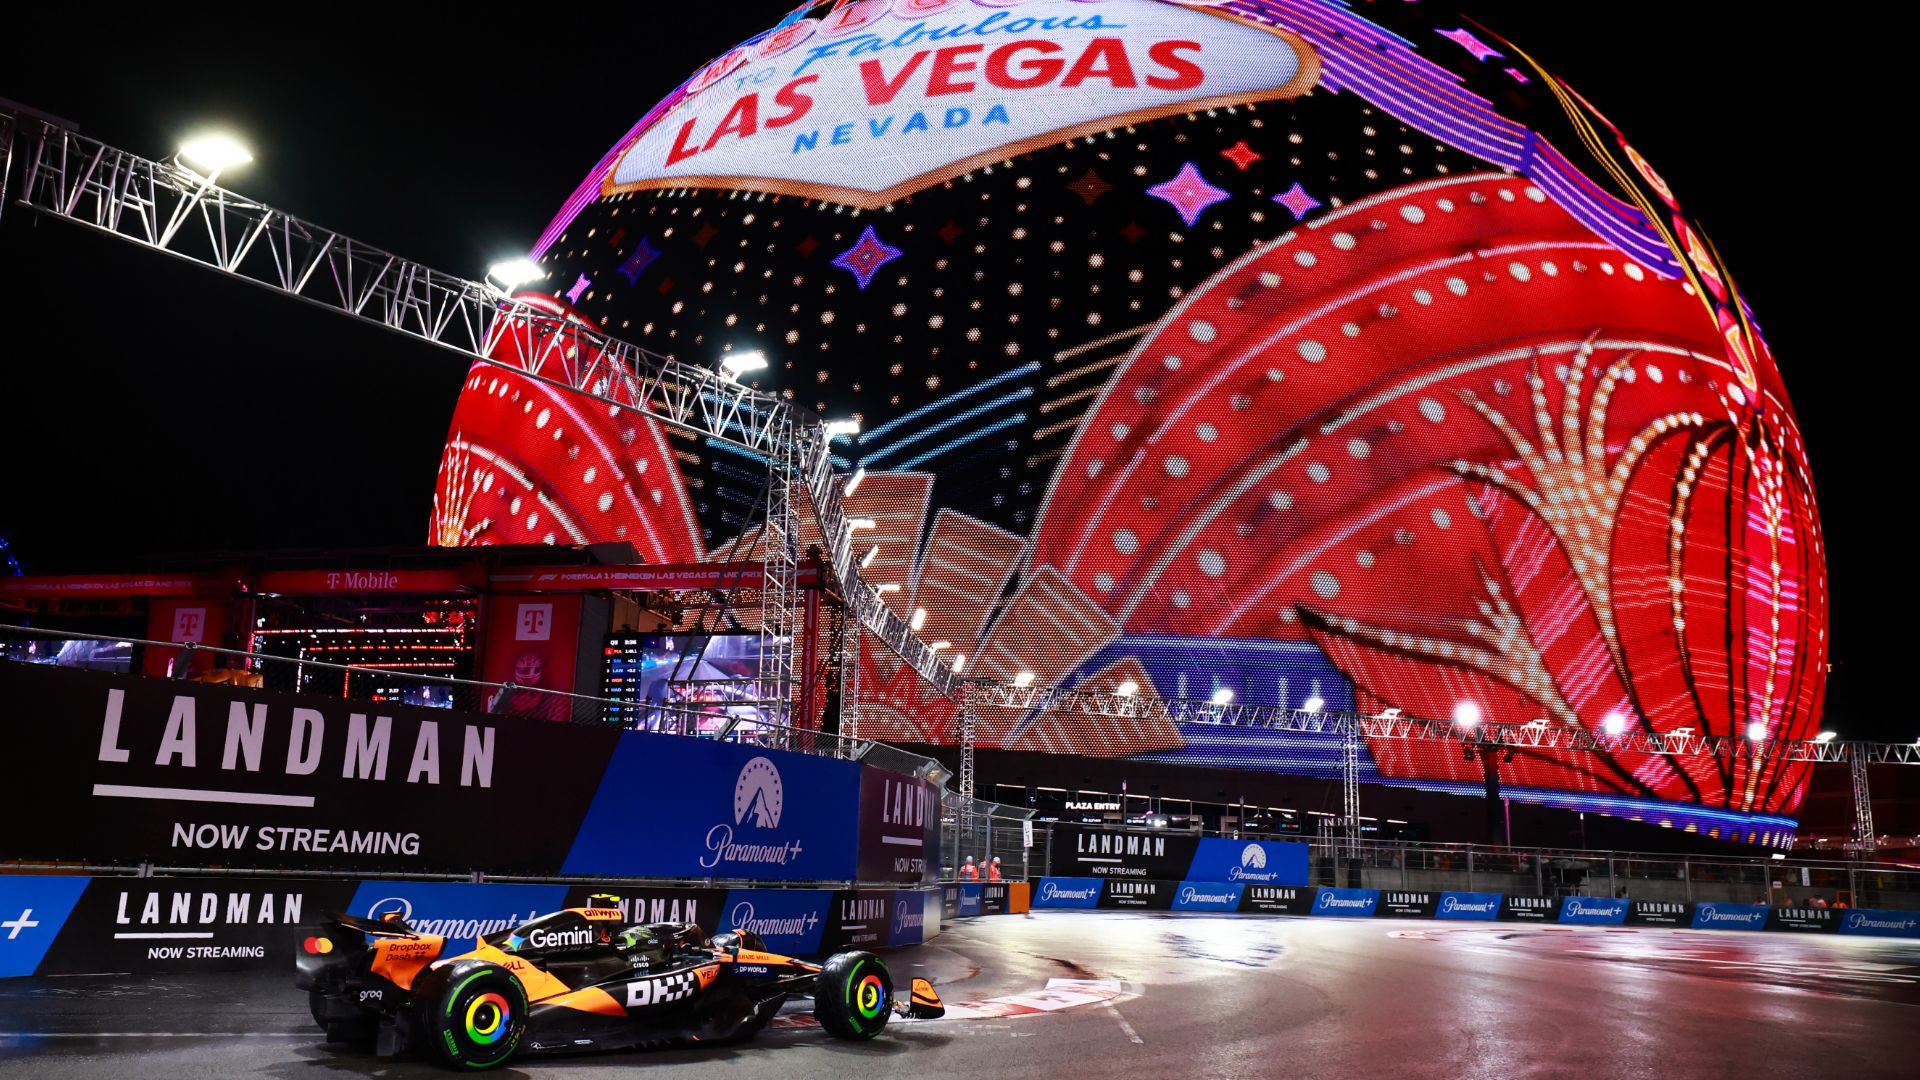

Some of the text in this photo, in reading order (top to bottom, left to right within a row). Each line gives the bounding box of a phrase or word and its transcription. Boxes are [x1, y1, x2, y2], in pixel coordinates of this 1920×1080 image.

[735, 11, 1127, 91] TO Fabulous
[664, 37, 1205, 168] LAS VEGAS
[793, 104, 1010, 154] NEVADA
[344, 573, 398, 589] Mobile
[98, 688, 495, 788] LANDMAN
[1065, 802, 1092, 810] PLAZA
[172, 822, 420, 855] NOW STREAMING
[700, 824, 802, 868] Paramount+
[1077, 833, 1165, 857] LANDMAN
[895, 857, 910, 872] NOW
[1092, 866, 1147, 876] NOW STREAMING
[1228, 866, 1278, 882] Paramount+
[1041, 882, 1097, 901] Paramount+
[1110, 882, 1156, 894] LANDMAN
[1180, 886, 1236, 904] Paramount+
[1251, 888, 1296, 900] LANDMAN
[1319, 892, 1373, 909] Paramount+
[1387, 892, 1429, 904] LANDMAN
[1442, 896, 1495, 912] Paramount+
[1509, 898, 1552, 908] LANDMAN
[116, 892, 302, 924] LANDMAN
[584, 910, 621, 918] allwyn
[842, 899, 884, 920] LANDMAN
[1566, 900, 1622, 917] Paramount+
[1636, 902, 1684, 913] LANDMAN
[1700, 906, 1762, 922] Paramount+
[1779, 908, 1831, 920] LANDMAN
[1848, 912, 1917, 929] Paramount+
[530, 925, 592, 948] Gemini
[148, 946, 265, 959] NOW STREAMING
[389, 943, 432, 952] Dropbox
[386, 953, 410, 962] Dash
[360, 990, 382, 1001] groq
[626, 972, 694, 1007] OKX
